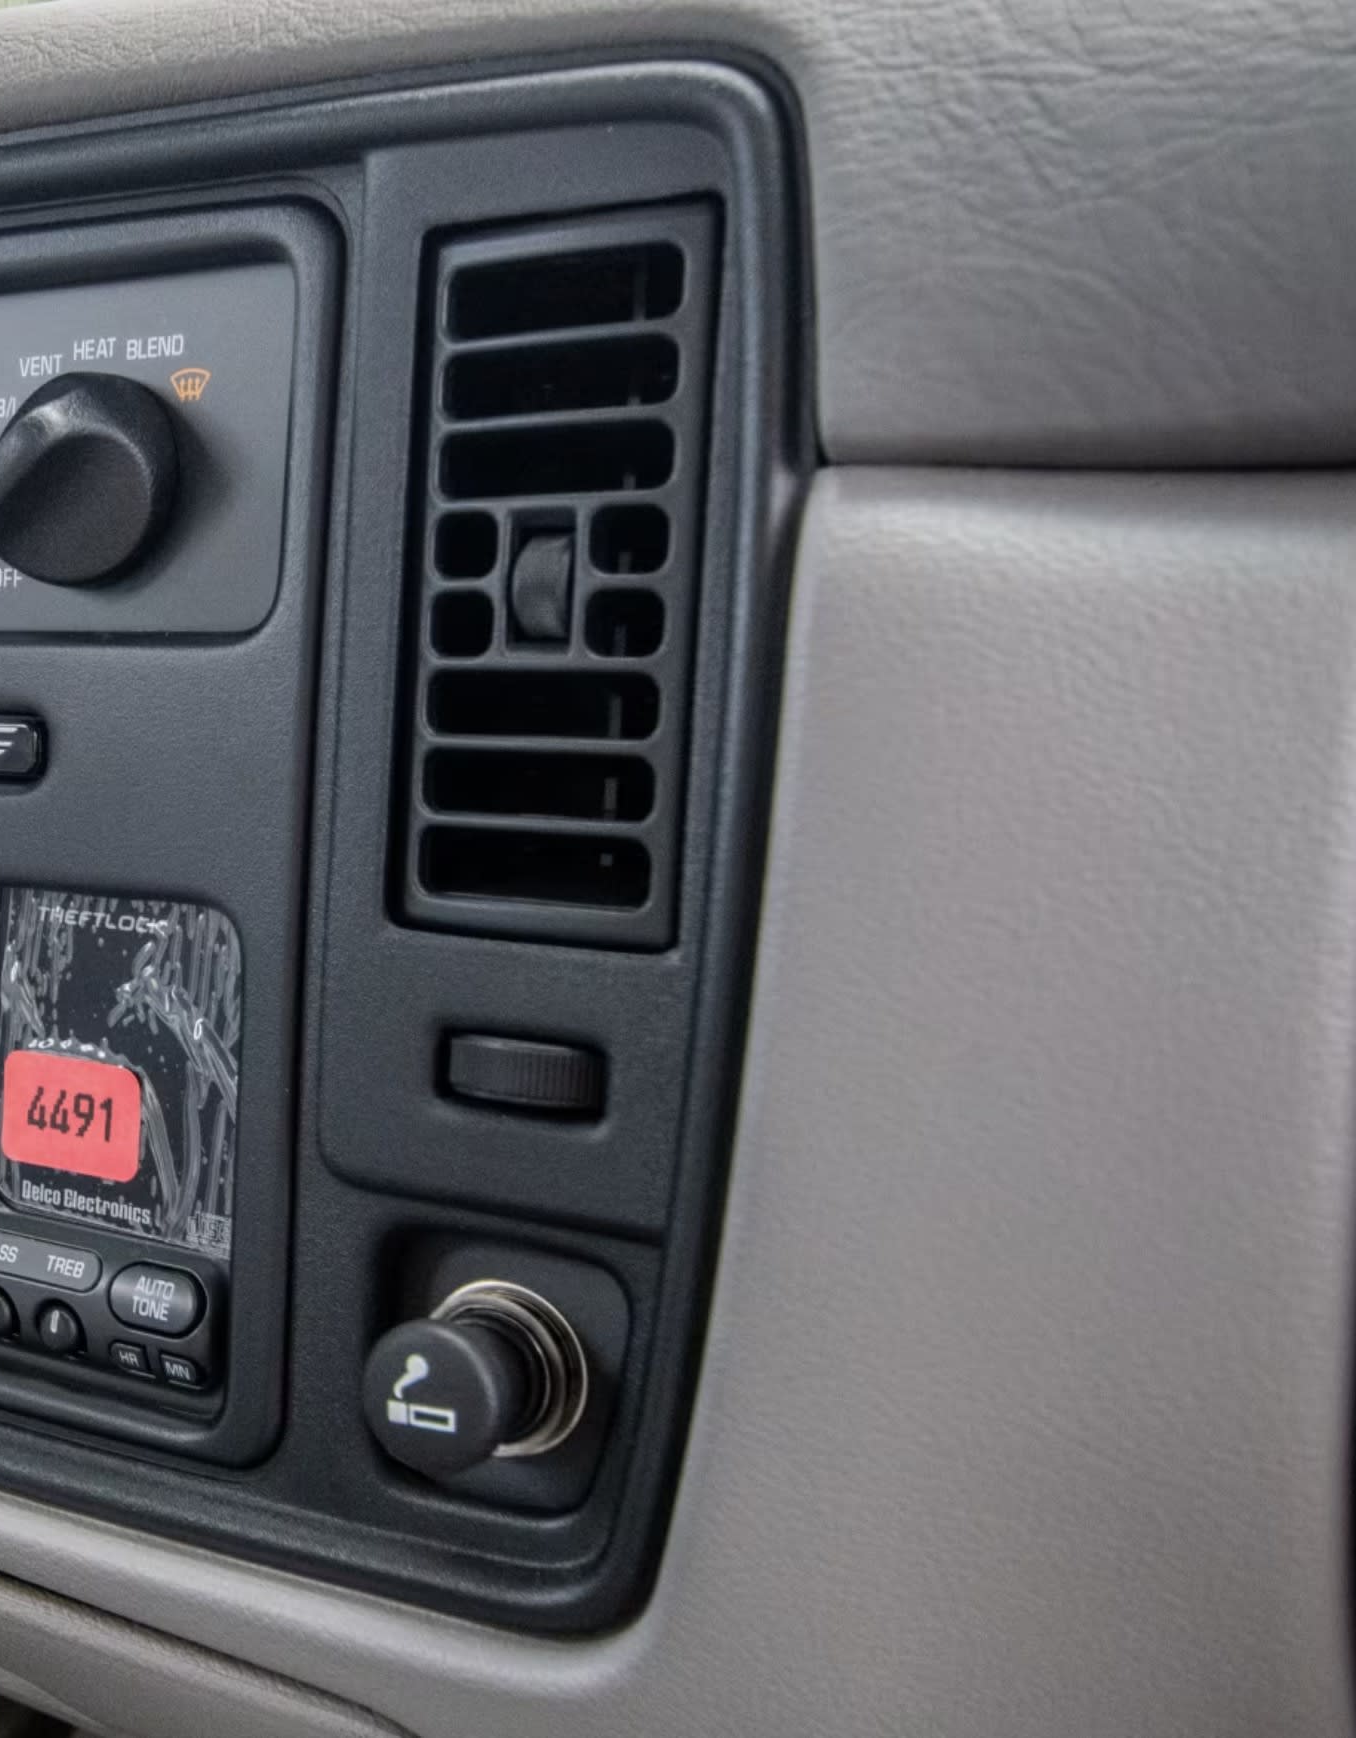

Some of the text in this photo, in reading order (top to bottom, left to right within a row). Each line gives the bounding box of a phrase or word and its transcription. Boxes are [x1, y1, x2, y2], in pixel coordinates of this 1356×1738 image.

[74, 337, 116, 361] HEAT
[126, 334, 185, 360] BLEND
[19, 354, 63, 377] VENT
[37, 905, 168, 936] THEFTLOCK
[27, 1086, 113, 1143] 4491
[21, 1180, 152, 1225] Delco Electronics
[46, 1254, 85, 1279] TREB
[135, 1275, 175, 1301] AUTO
[132, 1295, 170, 1322] TONE
[119, 1349, 140, 1368] HR
[165, 1360, 191, 1381] MN
